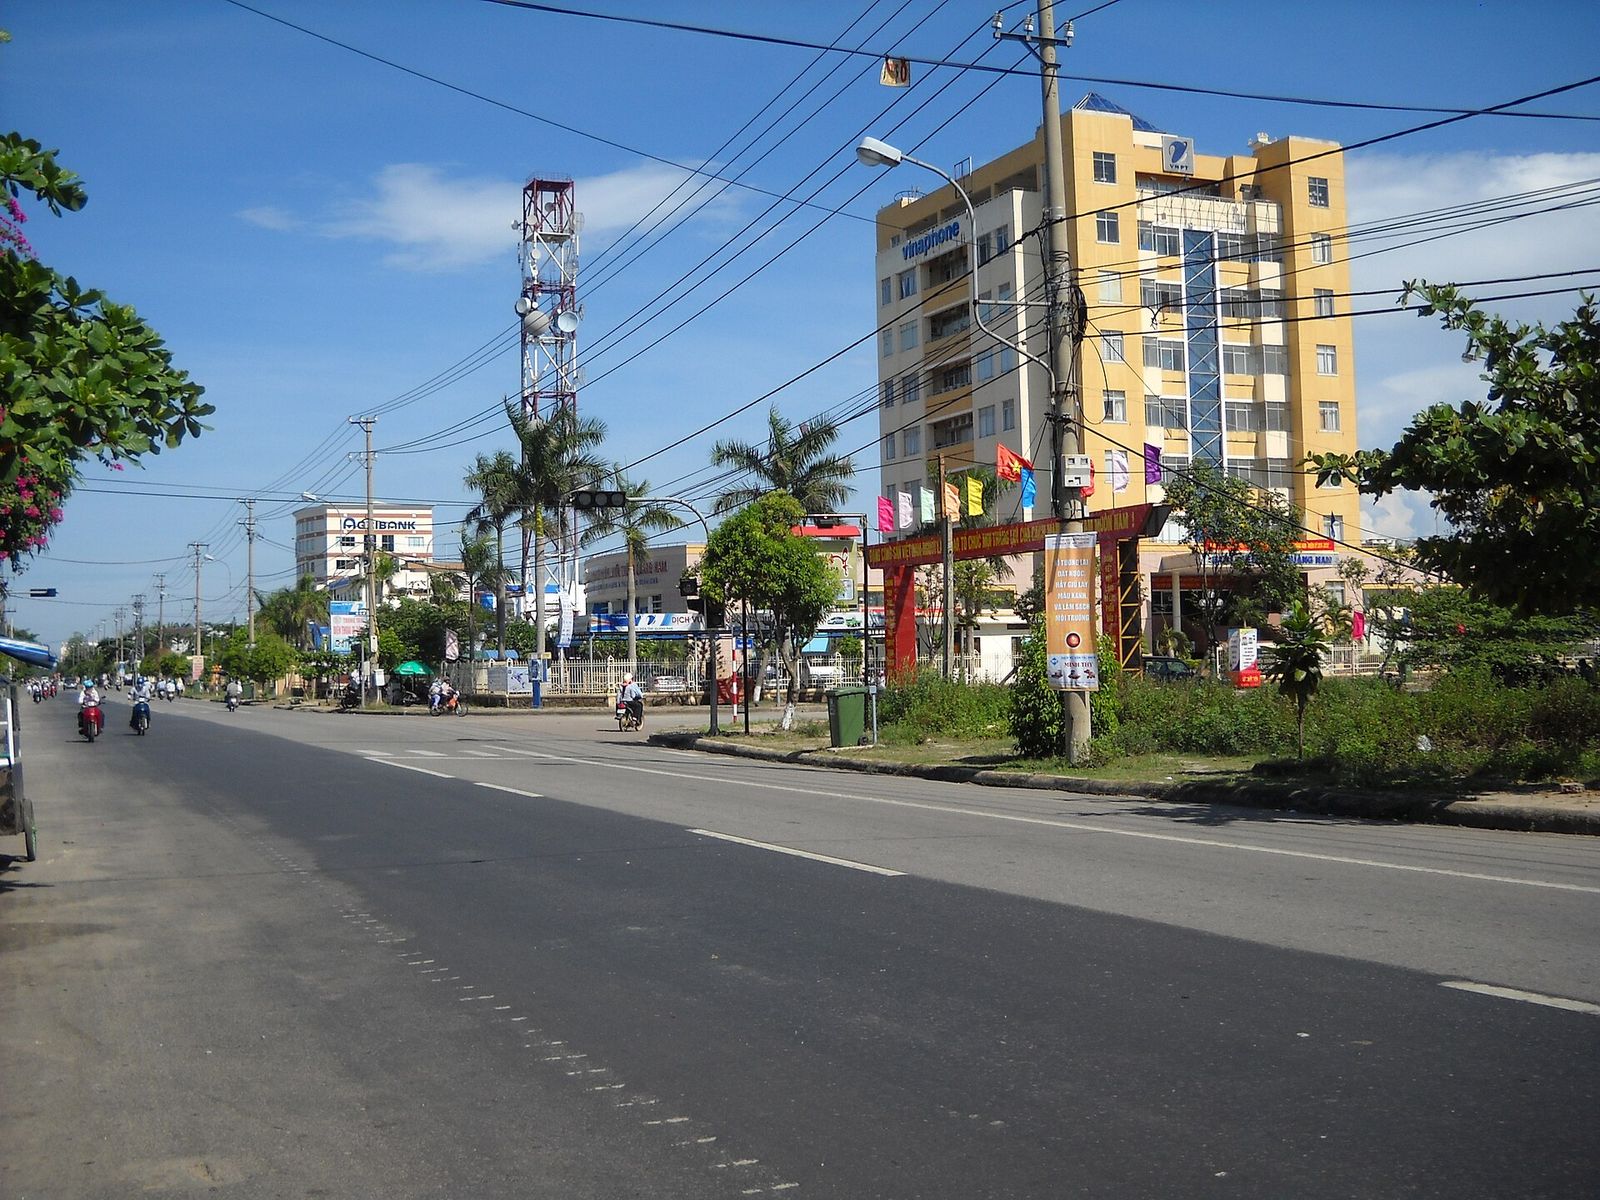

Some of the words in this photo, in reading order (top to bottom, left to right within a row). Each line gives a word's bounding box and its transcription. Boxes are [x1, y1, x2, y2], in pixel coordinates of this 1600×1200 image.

[1169, 163, 1188, 171] VNPT
[902, 221, 960, 260] vinaphone
[343, 517, 416, 529] AGIBANK
[671, 616, 690, 625] DỊCH
